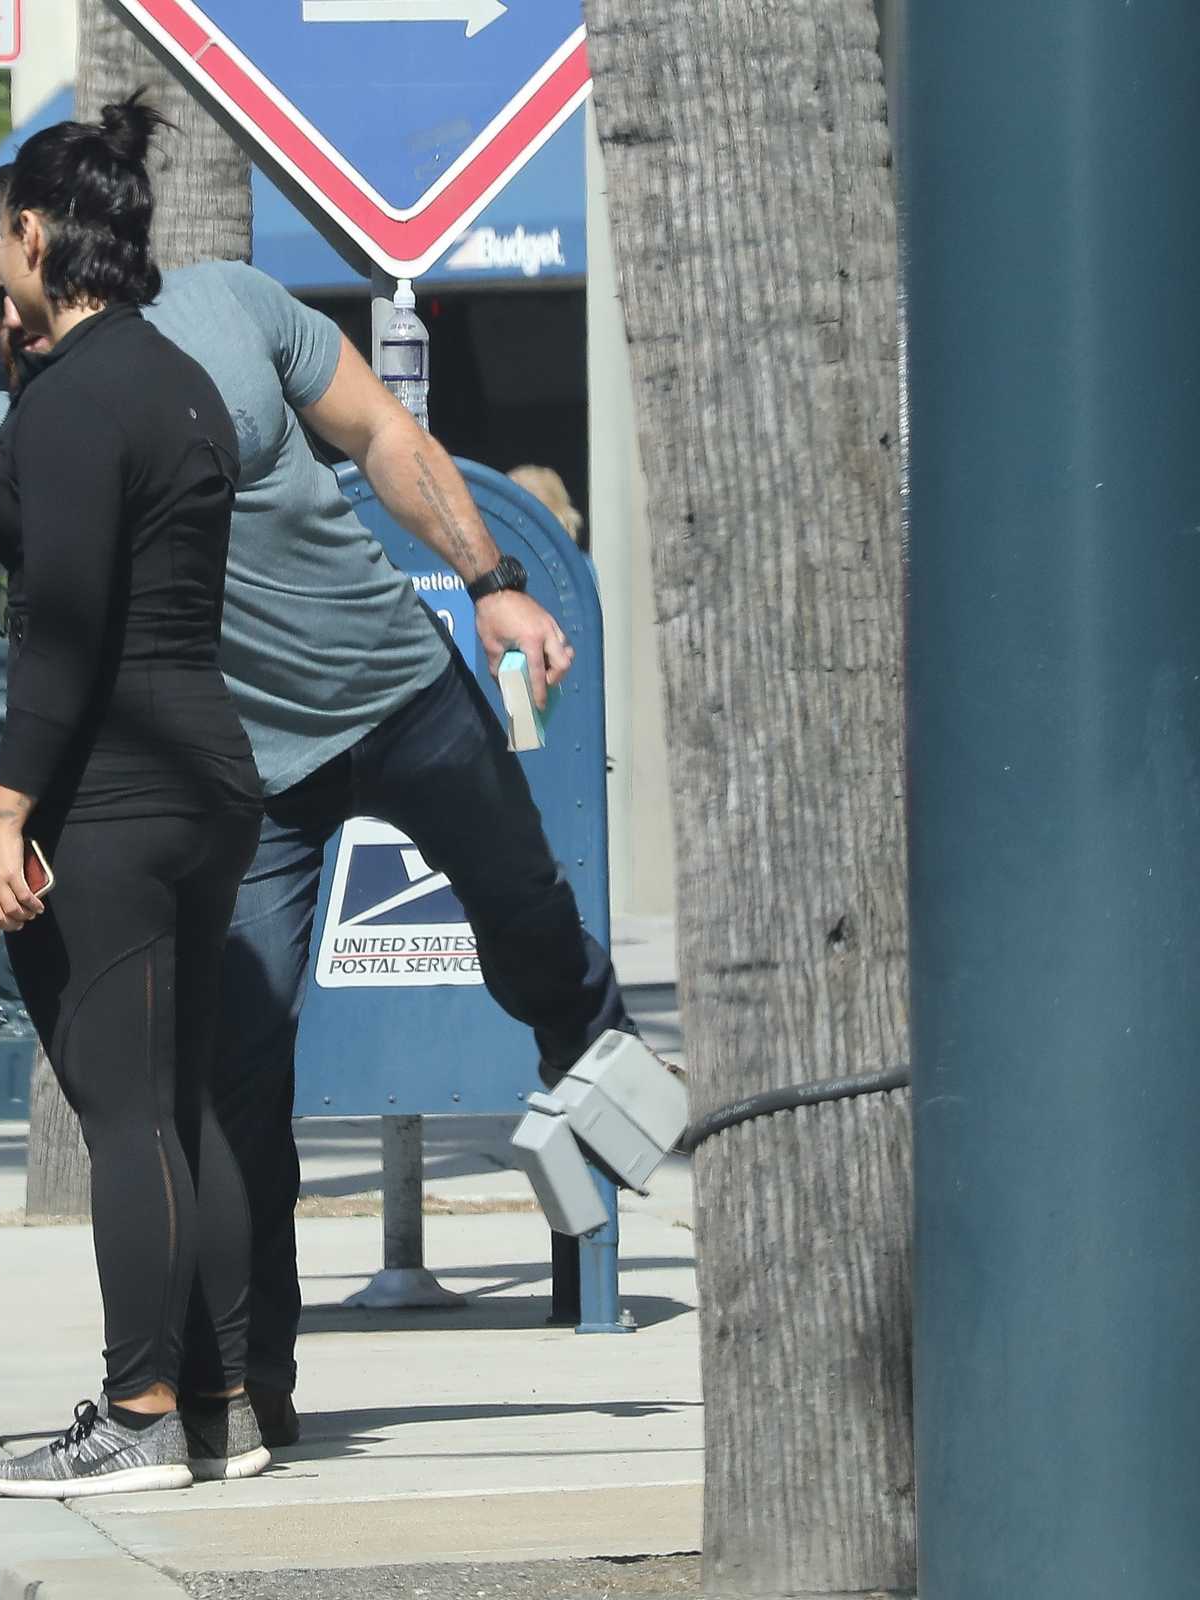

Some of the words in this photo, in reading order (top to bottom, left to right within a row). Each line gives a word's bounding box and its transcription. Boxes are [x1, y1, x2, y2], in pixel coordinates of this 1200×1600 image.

[479, 224, 562, 277] Budget
[333, 937, 405, 954] UNITED
[408, 935, 478, 952] STATES
[329, 958, 400, 974] POSTAL
[404, 957, 482, 973] SERVICE
